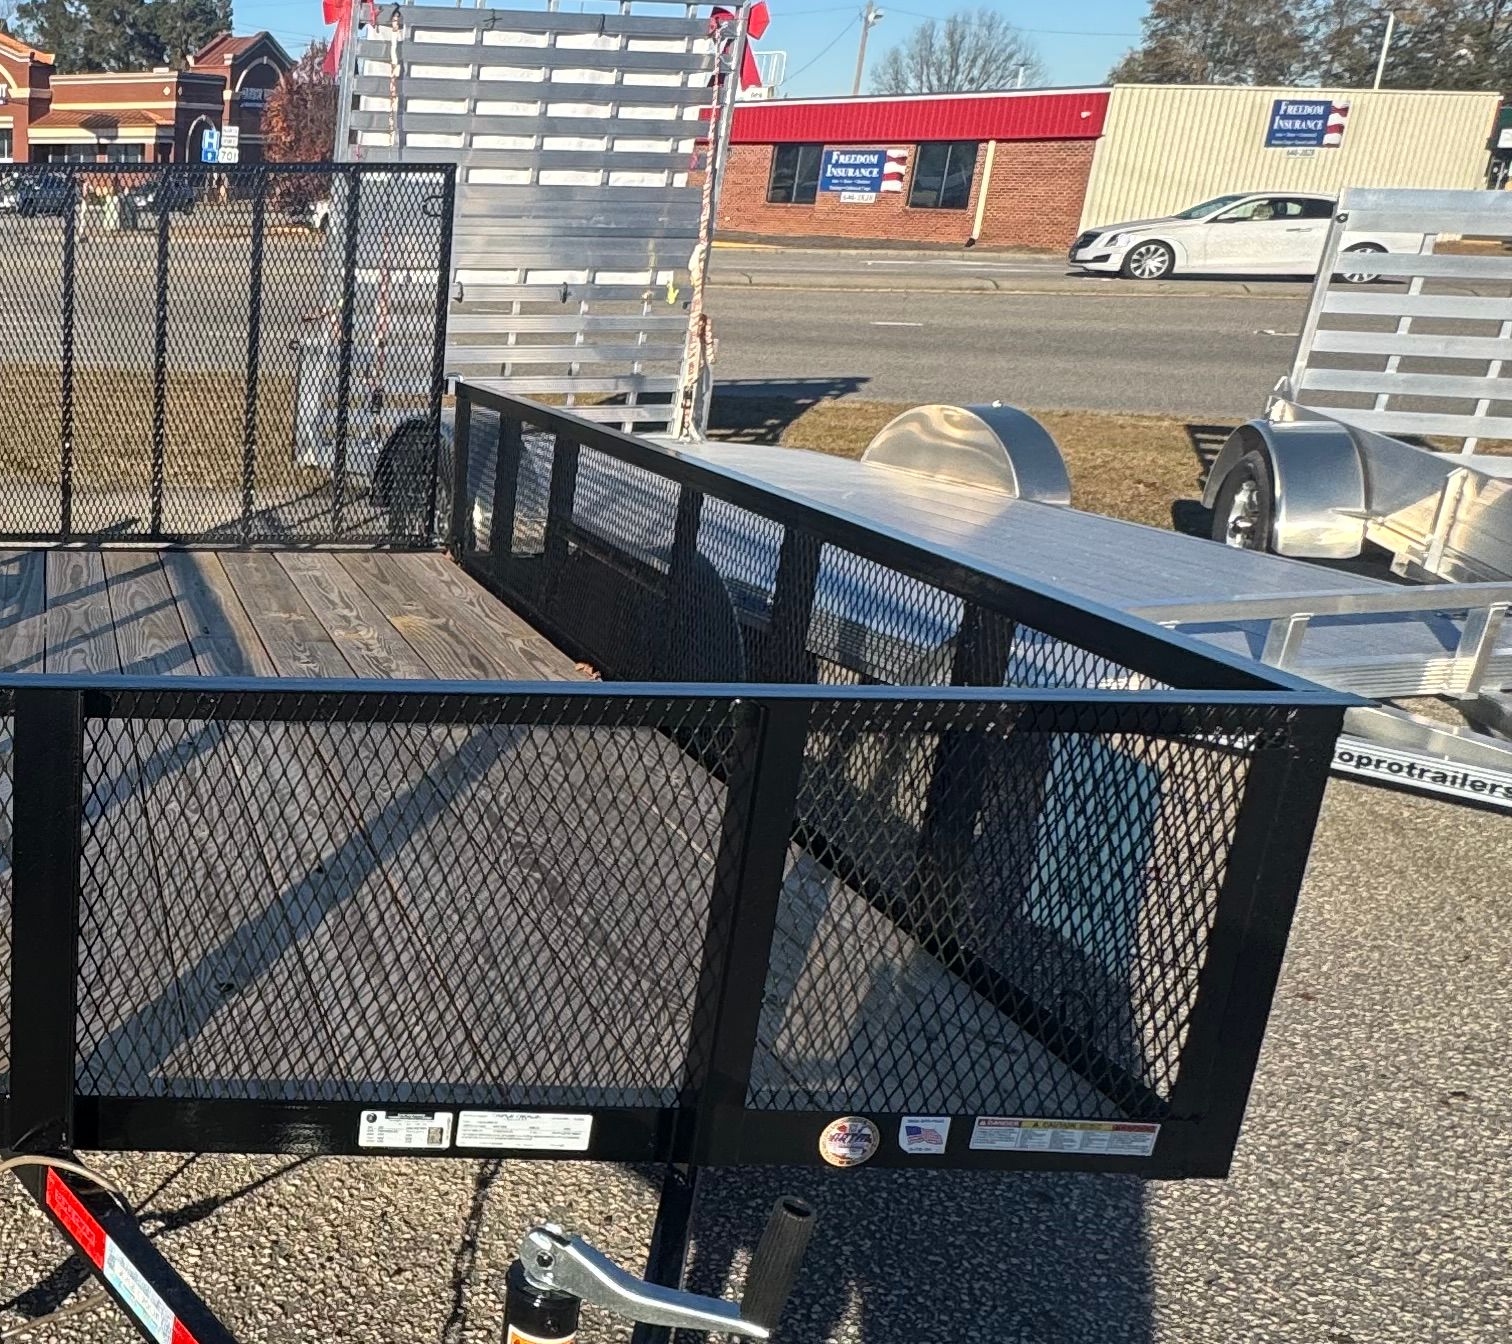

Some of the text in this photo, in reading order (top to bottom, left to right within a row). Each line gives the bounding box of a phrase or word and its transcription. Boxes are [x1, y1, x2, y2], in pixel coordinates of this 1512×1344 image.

[1279, 101, 1325, 115] FREEDOM
[1273, 115, 1324, 130] INSURANCE
[220, 151, 237, 161] 701
[831, 151, 879, 165] FREEDOM
[825, 164, 880, 178] INSURANCE
